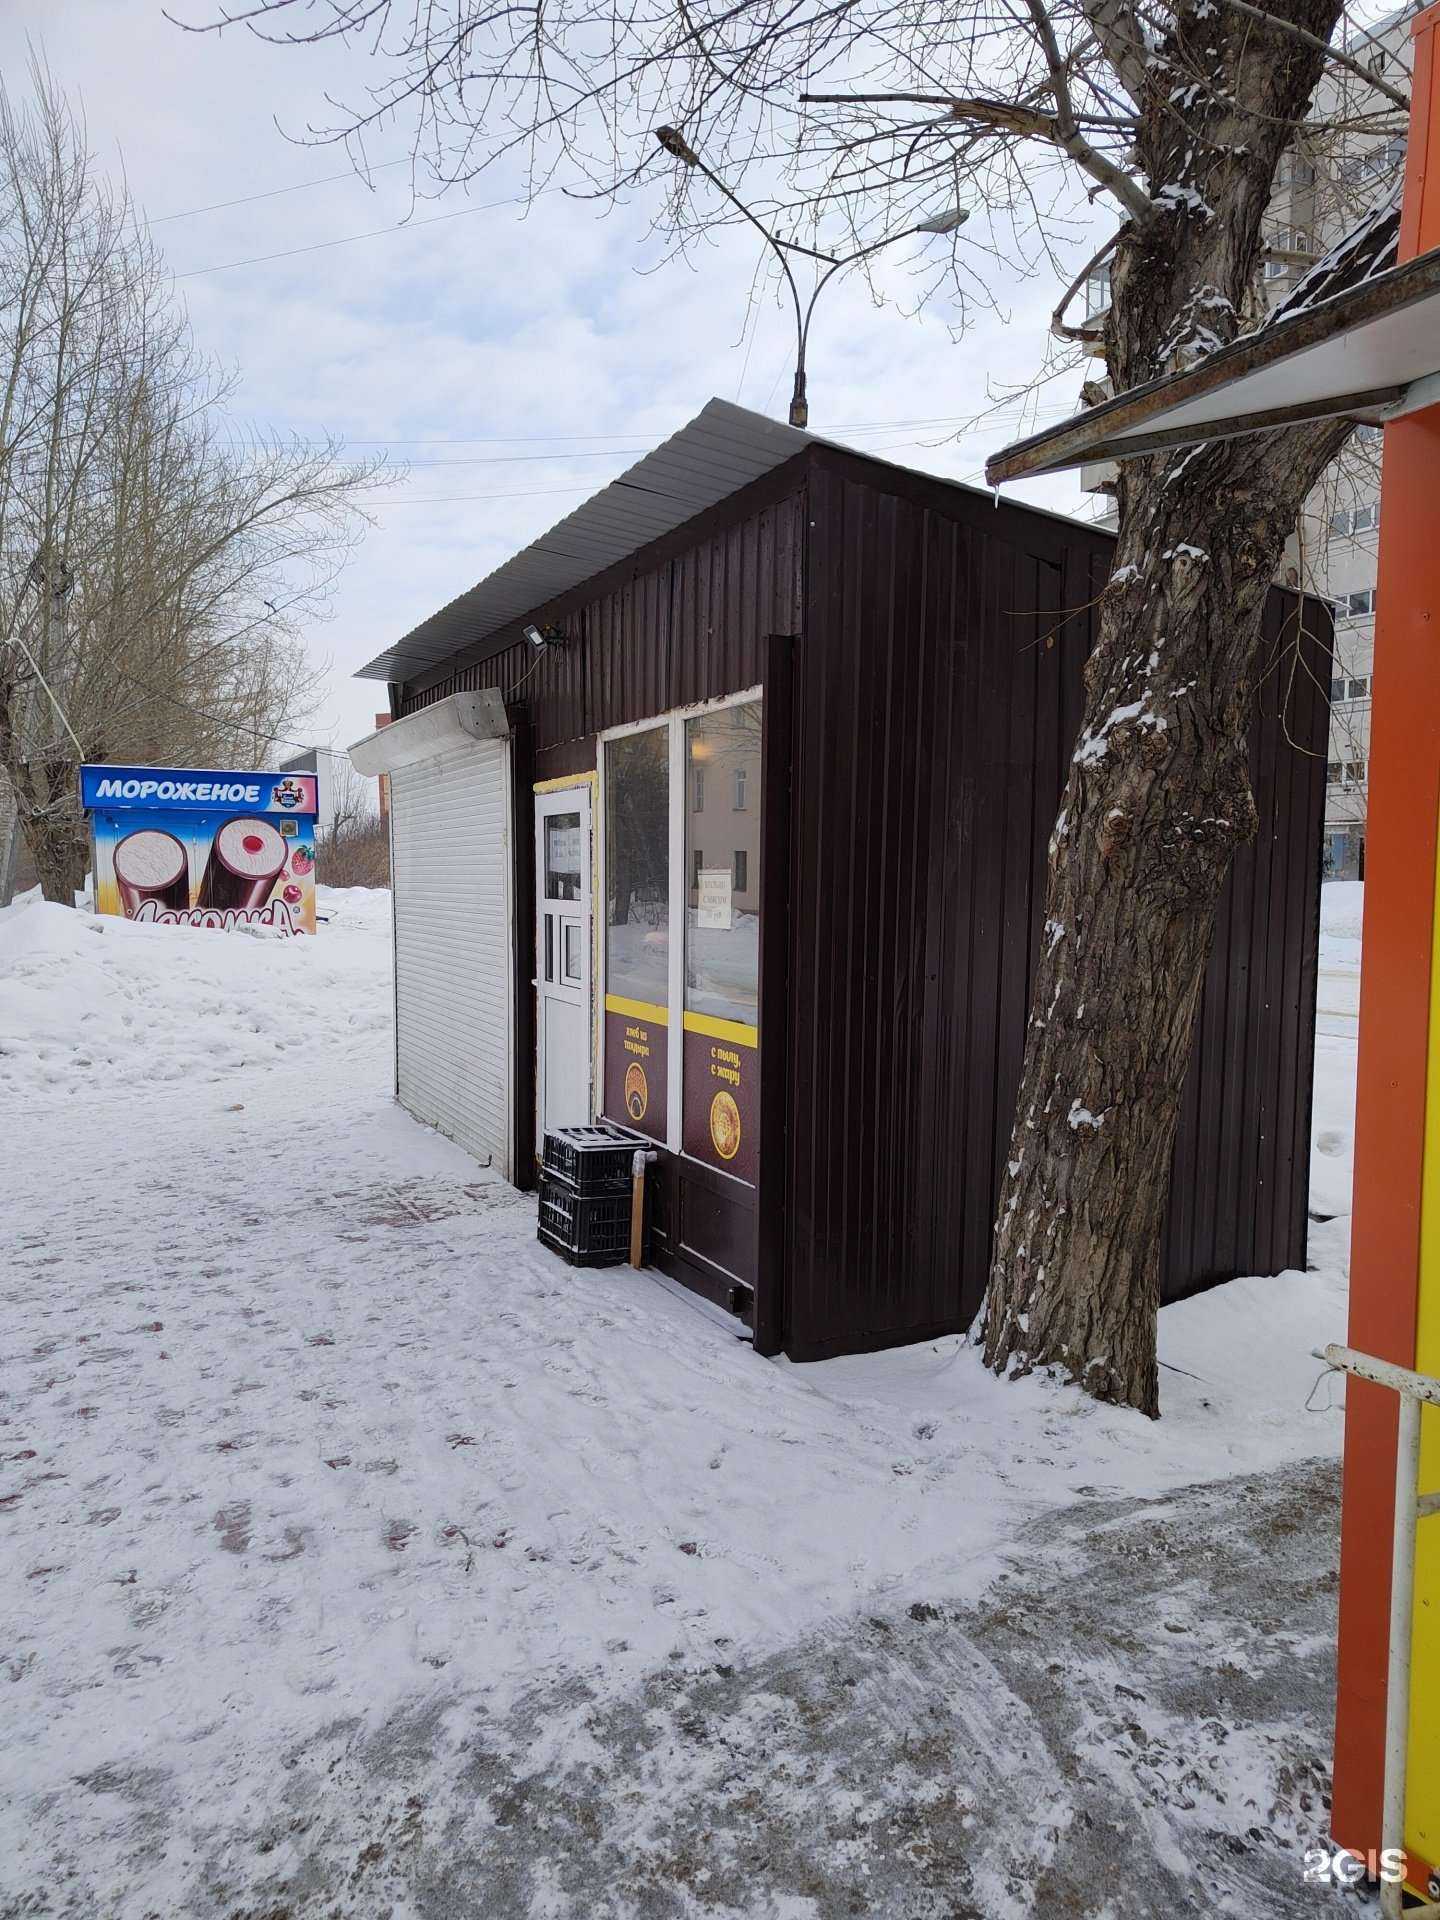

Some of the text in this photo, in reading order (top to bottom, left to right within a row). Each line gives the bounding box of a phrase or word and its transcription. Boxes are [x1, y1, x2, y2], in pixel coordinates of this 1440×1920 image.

[96, 779, 260, 802] МОРОЖЕНОЕ
[626, 1024, 648, 1041] хлеб из
[711, 1047, 741, 1067] с пылу,
[711, 1064, 740, 1086] с жару
